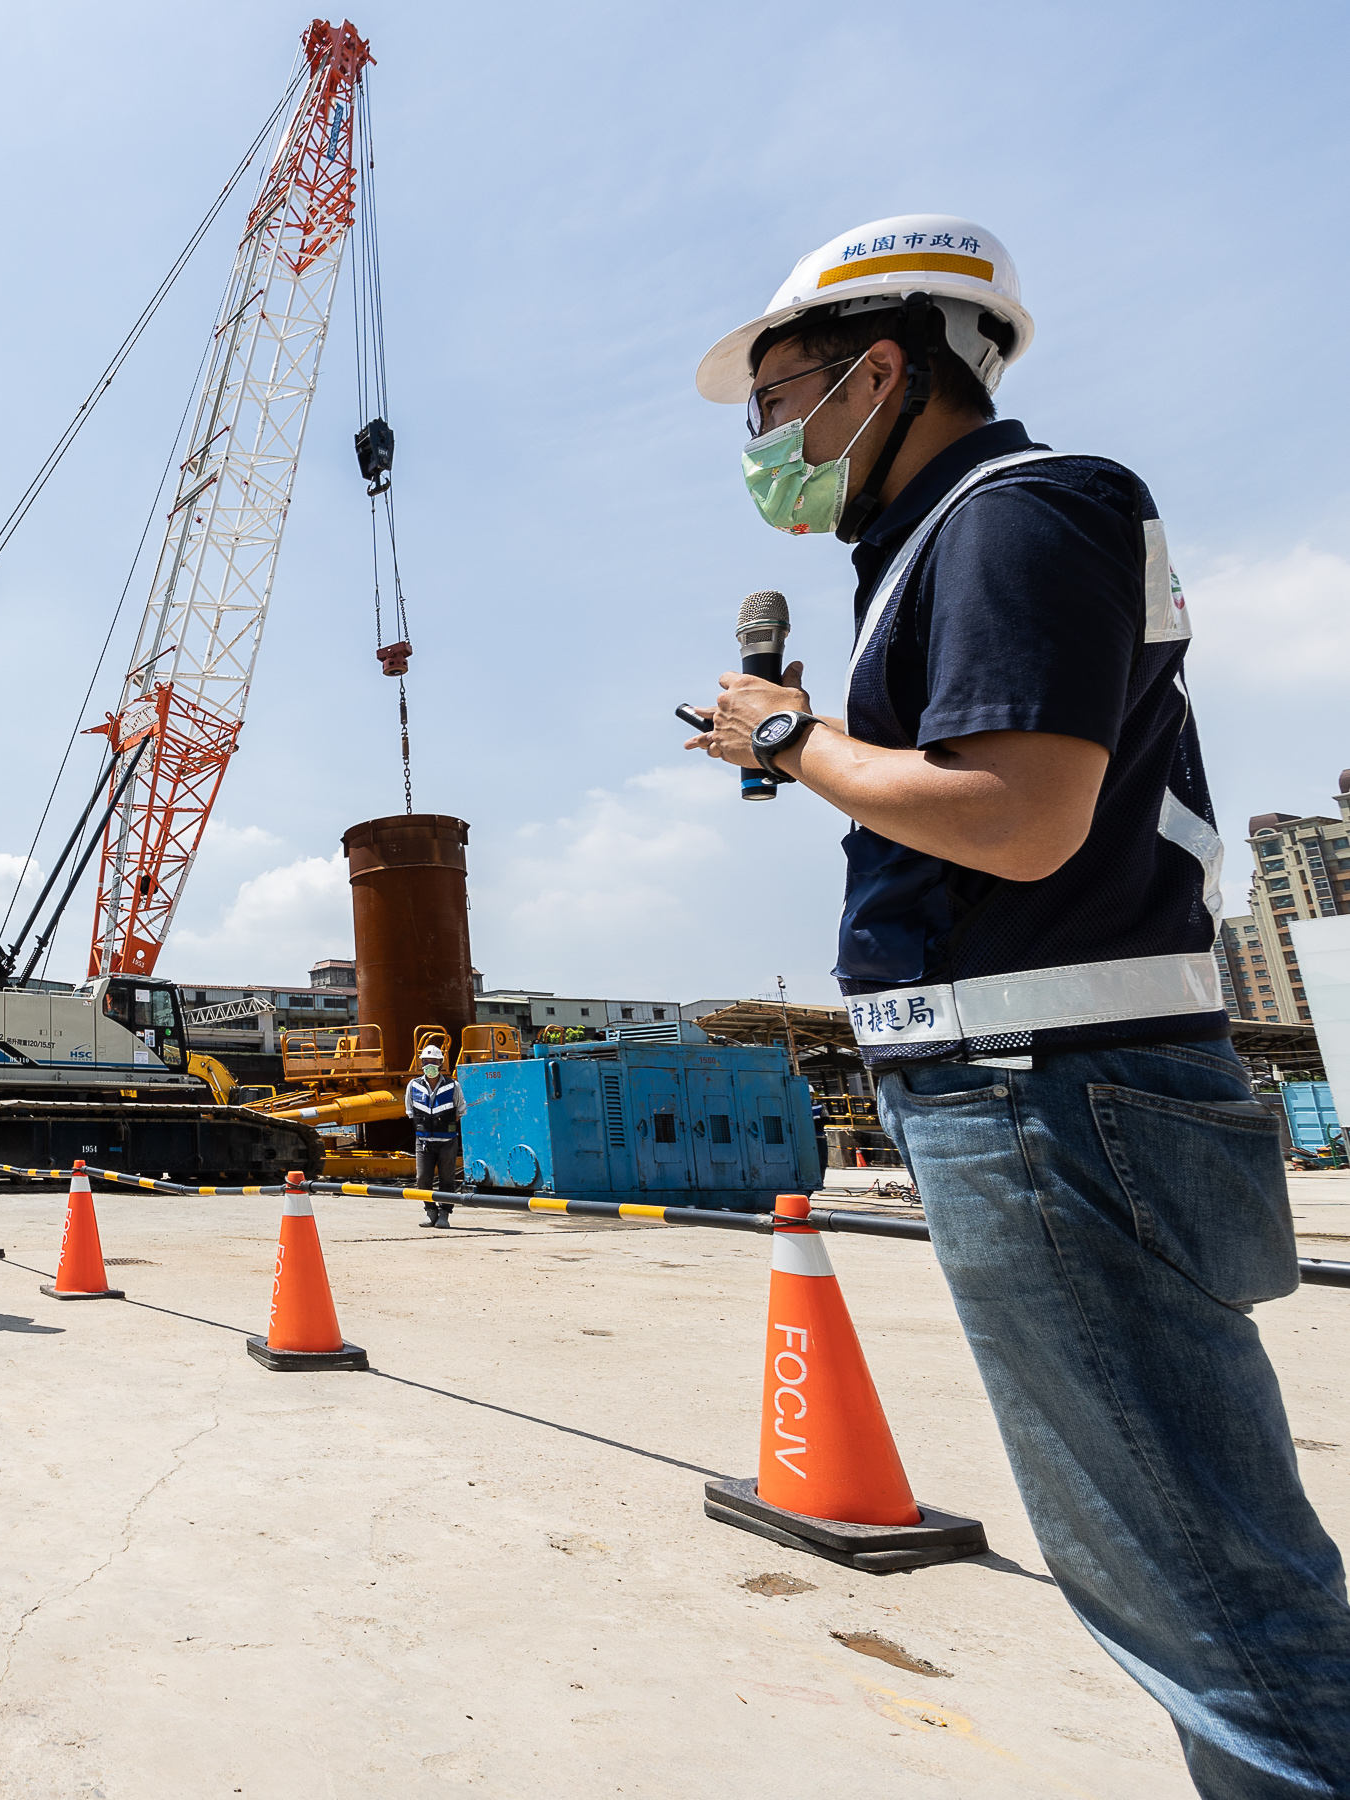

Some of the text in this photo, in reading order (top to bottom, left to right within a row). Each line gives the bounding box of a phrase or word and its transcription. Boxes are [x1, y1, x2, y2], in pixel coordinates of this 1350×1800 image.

[840, 232, 982, 261] 桃園市政府
[845, 996, 934, 1035] 市捷運局
[70, 1051, 93, 1059] HSC
[485, 1071, 502, 1080] 1580
[81, 1145, 98, 1153] 1954
[773, 1322, 808, 1480] FOCJV
